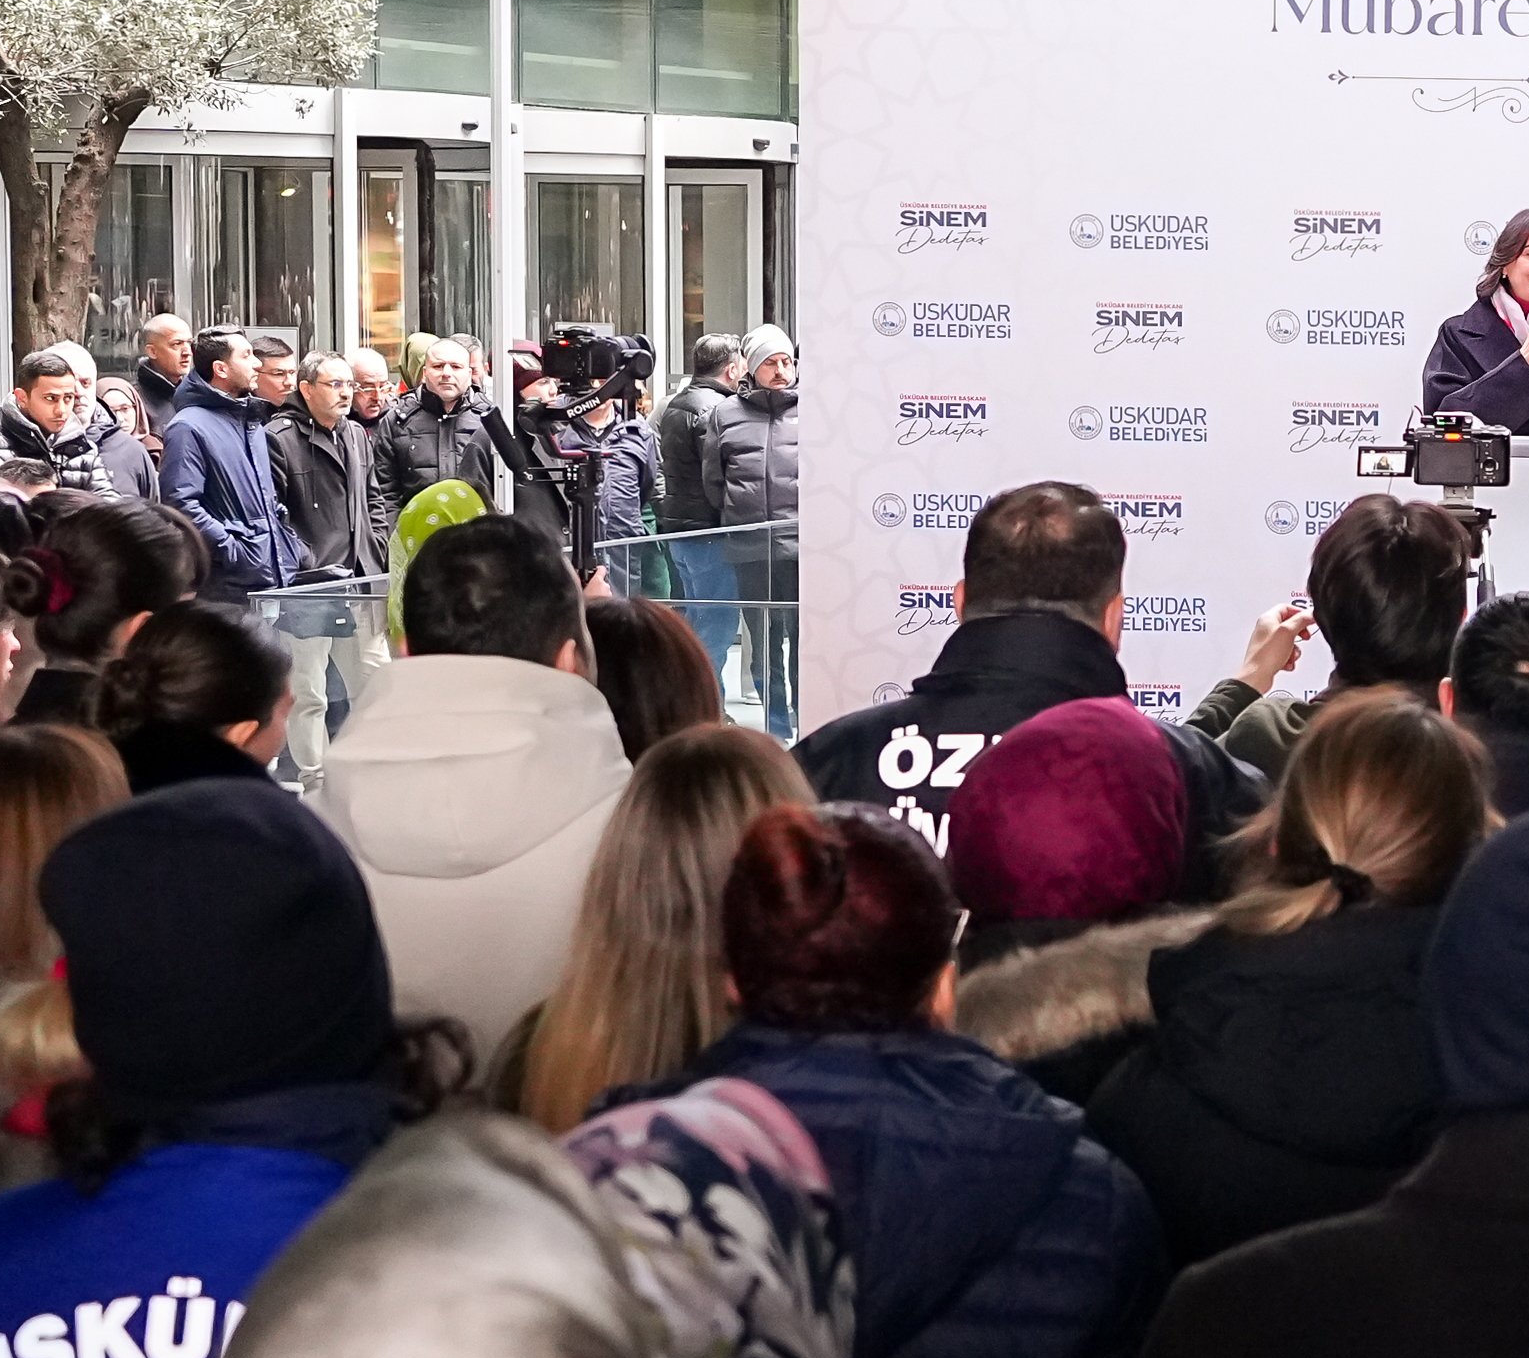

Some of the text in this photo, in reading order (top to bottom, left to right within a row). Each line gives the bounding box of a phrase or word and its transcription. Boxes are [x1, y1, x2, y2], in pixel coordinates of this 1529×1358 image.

[1110, 214, 1208, 234] ÜSKÜDAR
[913, 302, 1011, 322] ÜSKÜDAR
[1307, 309, 1405, 329] ÜSKÜDAR
[566, 396, 601, 419] RONIN
[1109, 406, 1207, 426] ÜSKÜDAR
[1123, 596, 1206, 616] SKÜDAR
